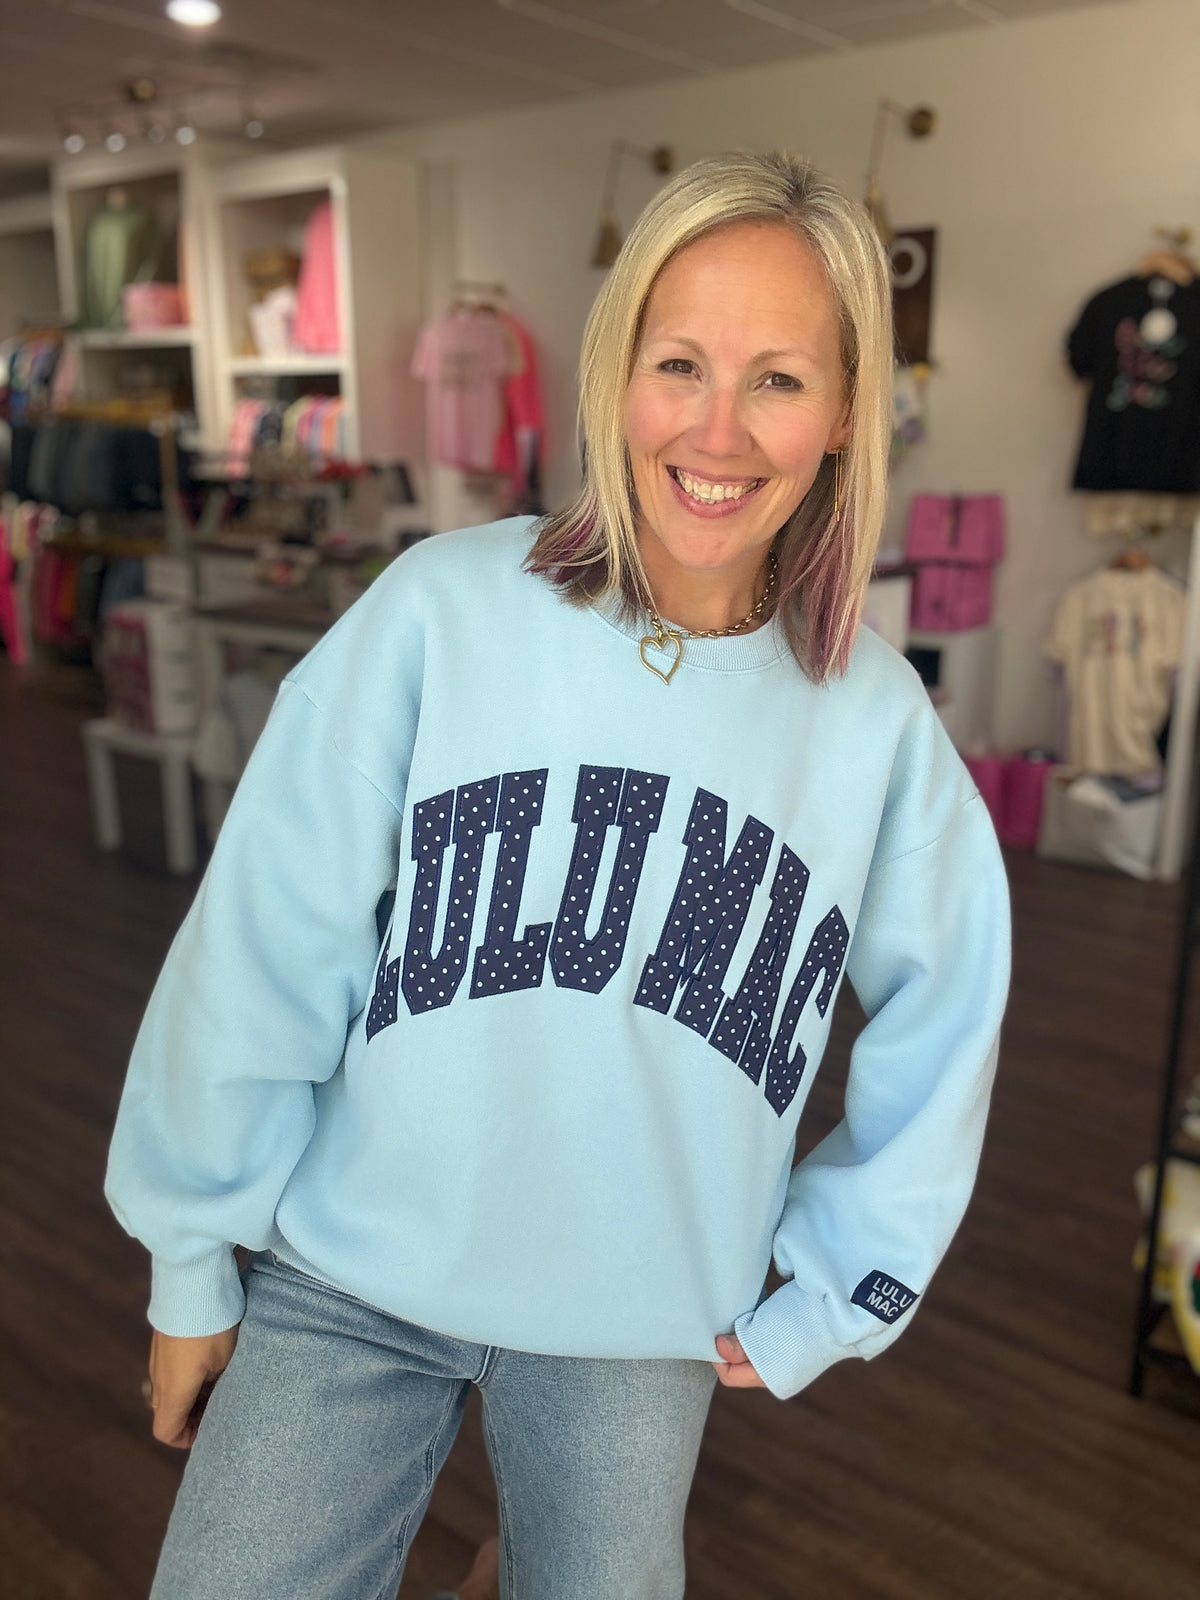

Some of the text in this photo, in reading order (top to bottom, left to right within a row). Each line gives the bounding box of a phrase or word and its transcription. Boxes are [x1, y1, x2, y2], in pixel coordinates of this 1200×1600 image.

[633, 786, 850, 1118] MAC
[866, 1291, 899, 1317] MAC
[872, 1277, 913, 1308] LULU
